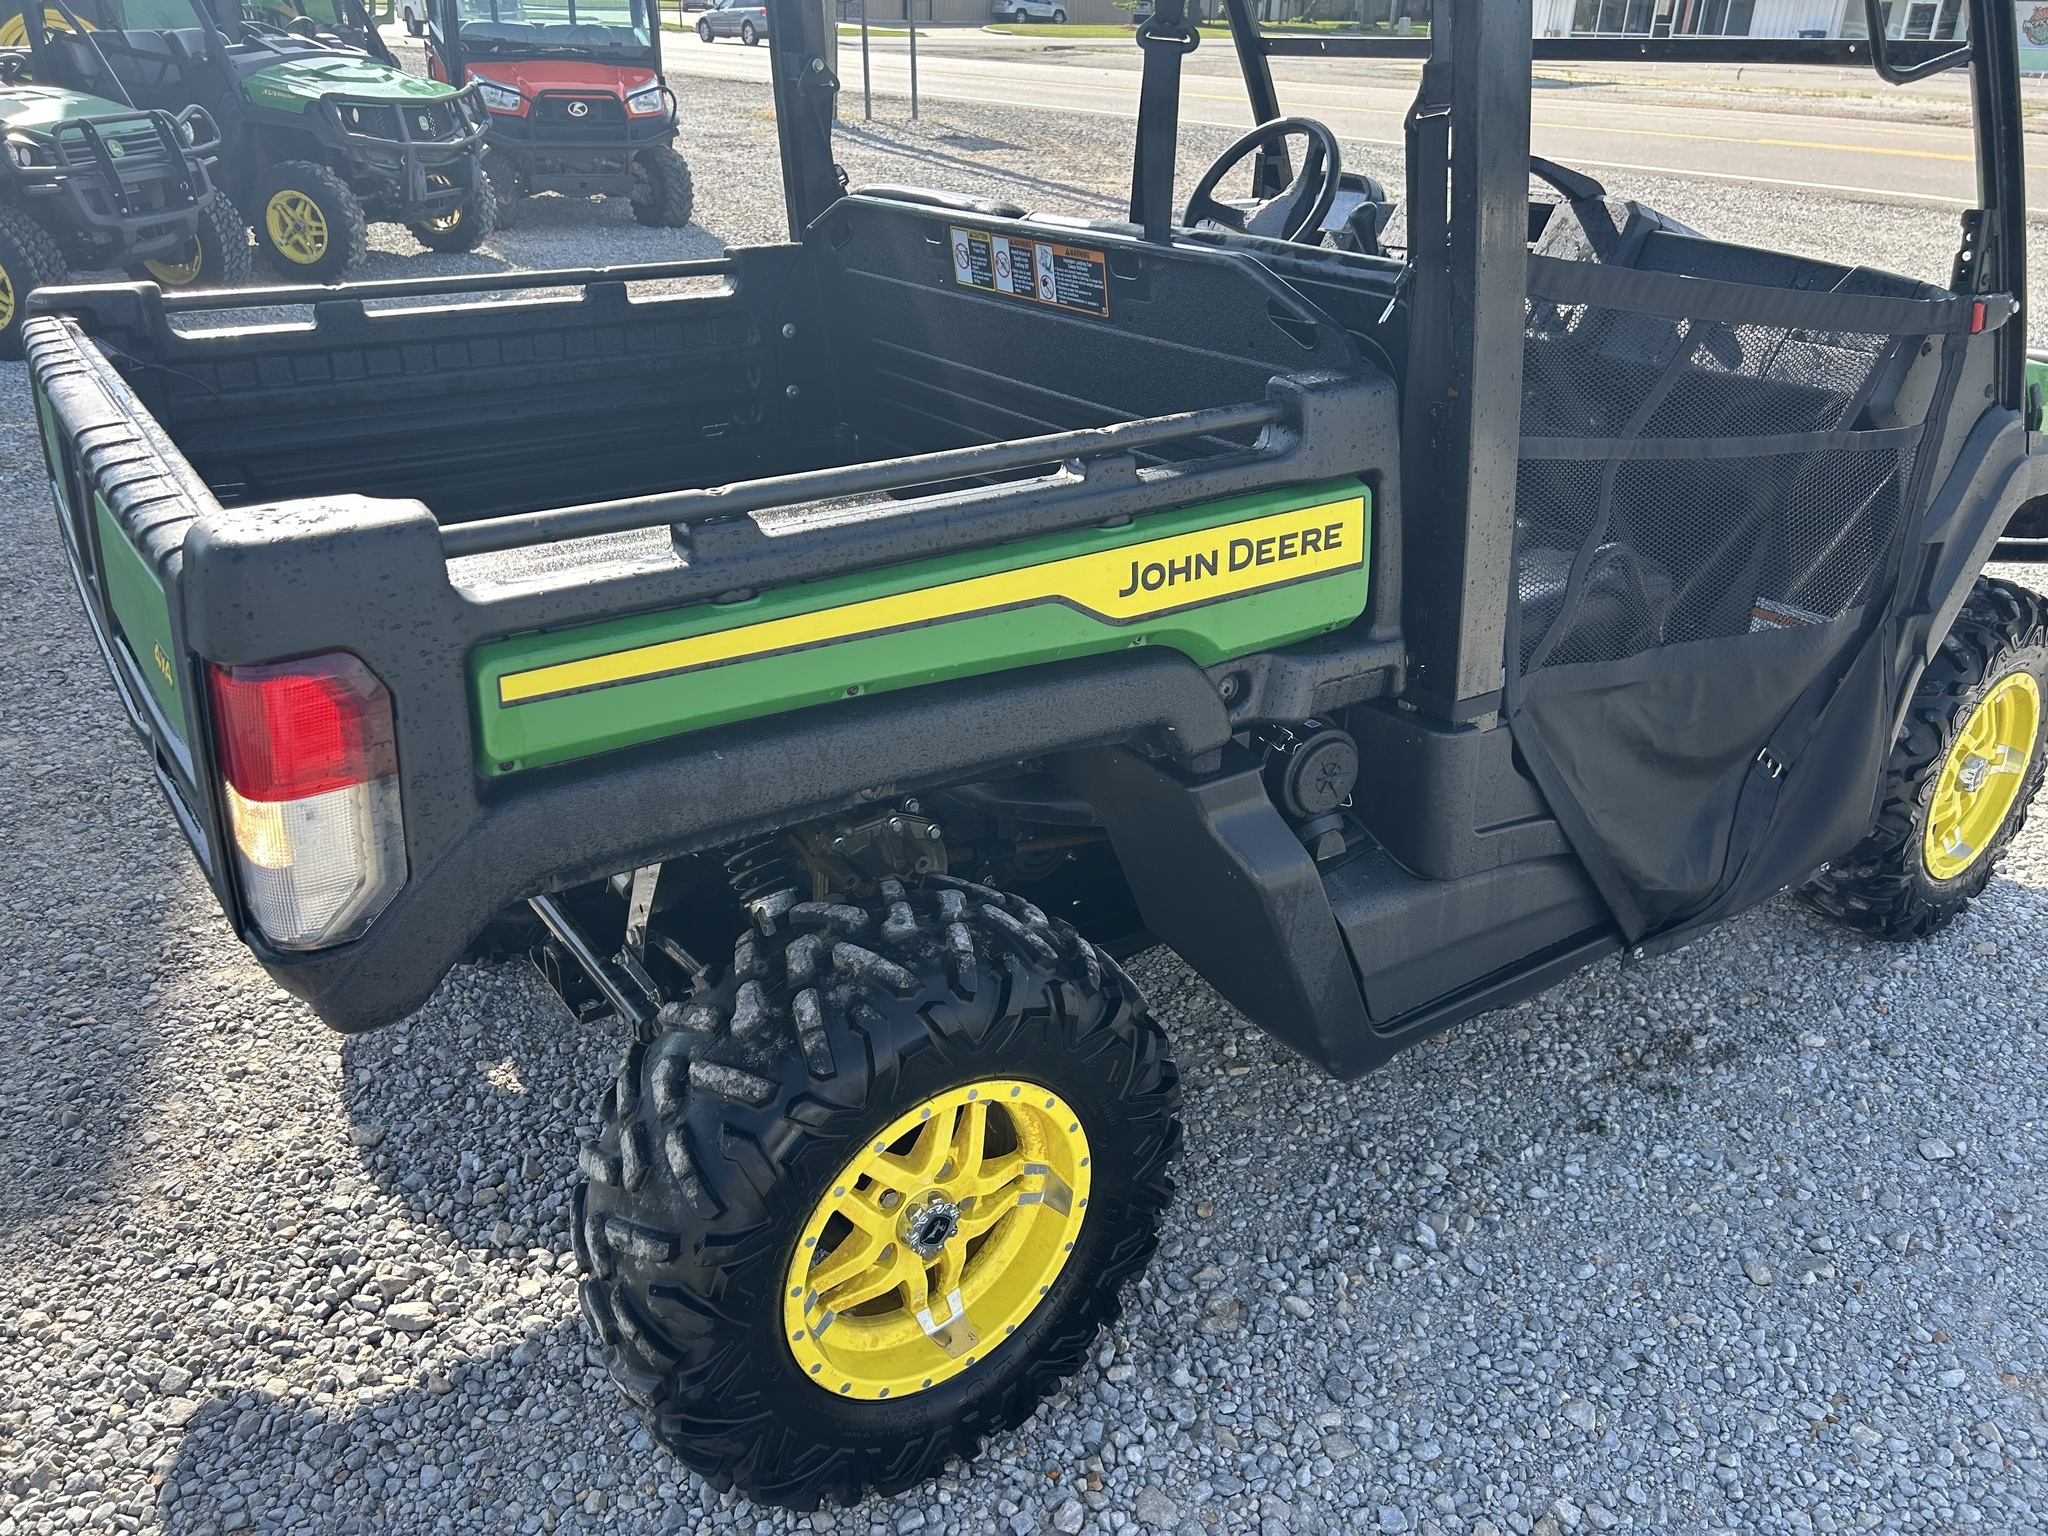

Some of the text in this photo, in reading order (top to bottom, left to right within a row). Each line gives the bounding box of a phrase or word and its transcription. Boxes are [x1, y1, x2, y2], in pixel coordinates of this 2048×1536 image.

[1069, 249, 1090, 260] WARNING
[1119, 522, 1344, 598] JOHN DEERE
